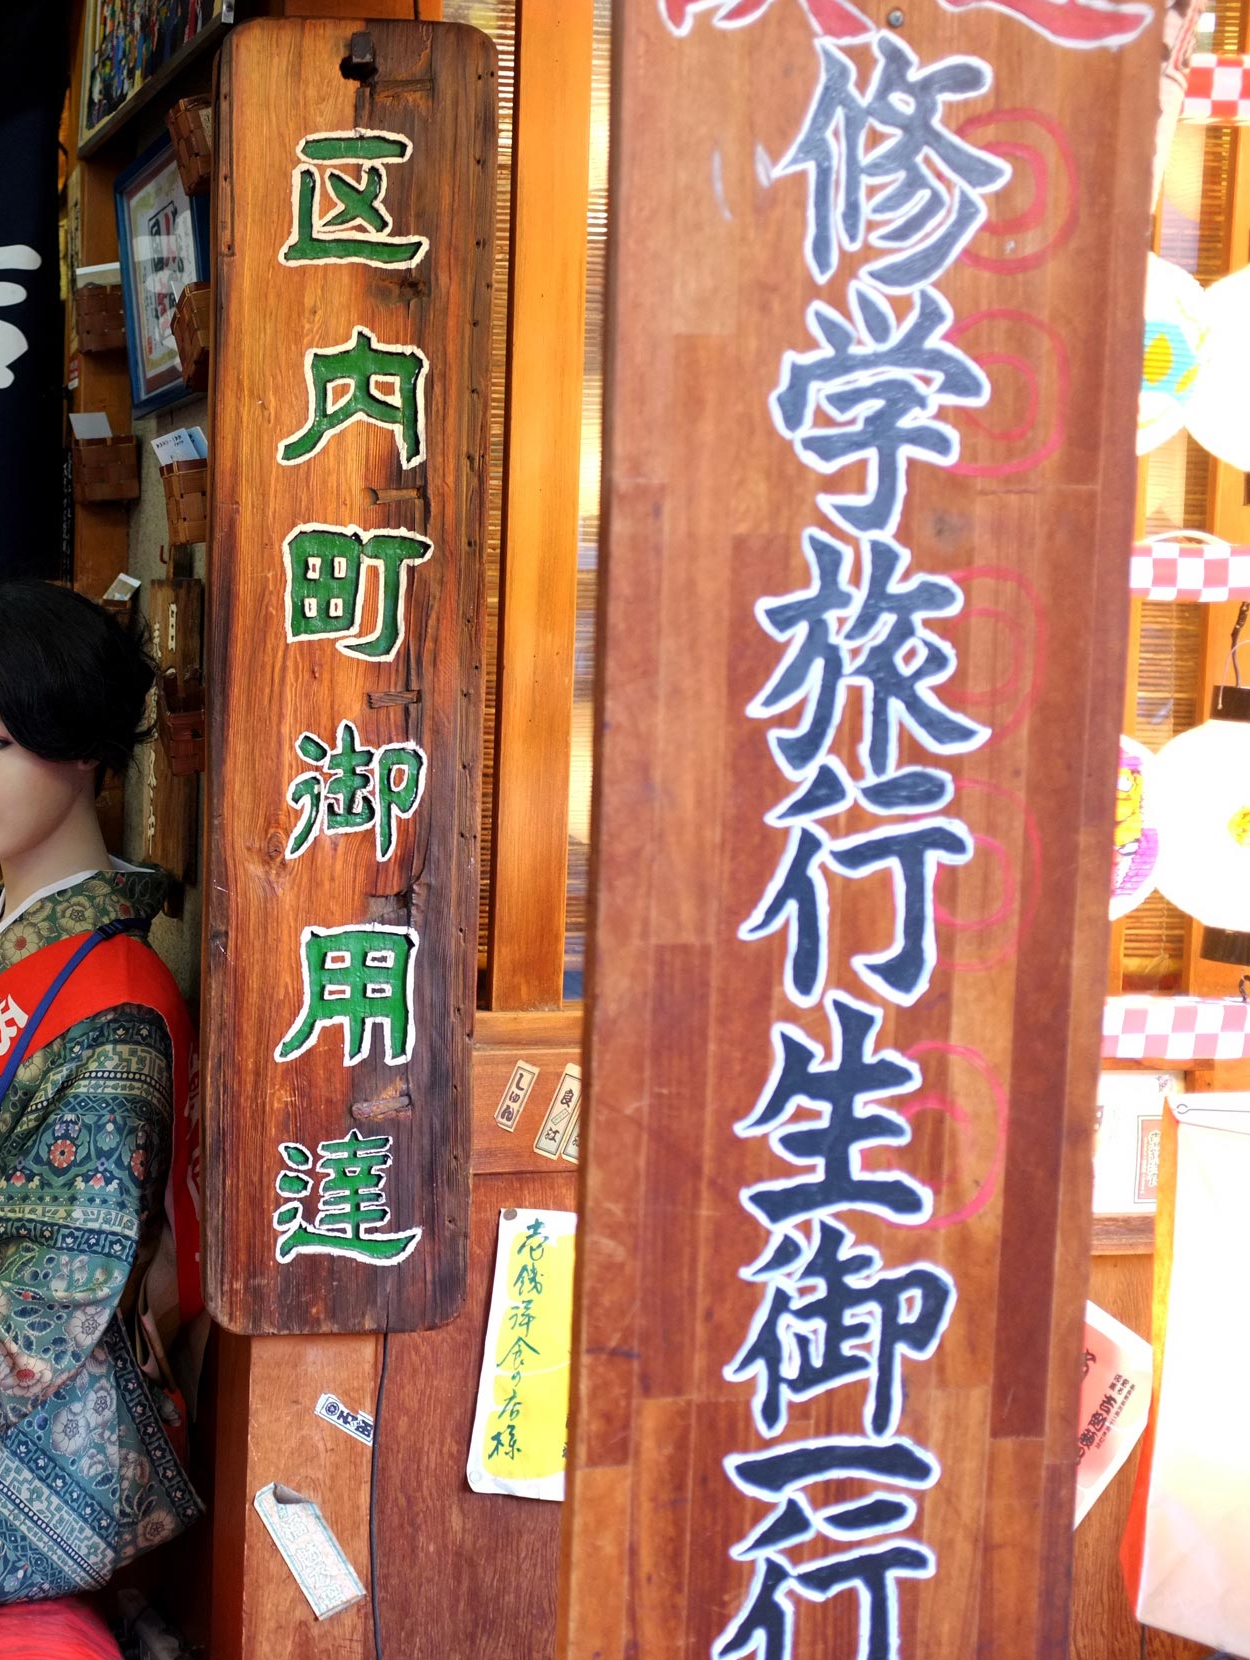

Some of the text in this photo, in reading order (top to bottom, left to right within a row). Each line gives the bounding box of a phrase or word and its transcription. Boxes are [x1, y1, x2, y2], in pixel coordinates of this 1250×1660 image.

[276, 127, 433, 1266] 区内町御用達
[500, 1072, 525, 1122] しゅん
[711, 29, 1012, 1660] 修学旅行生御一行
